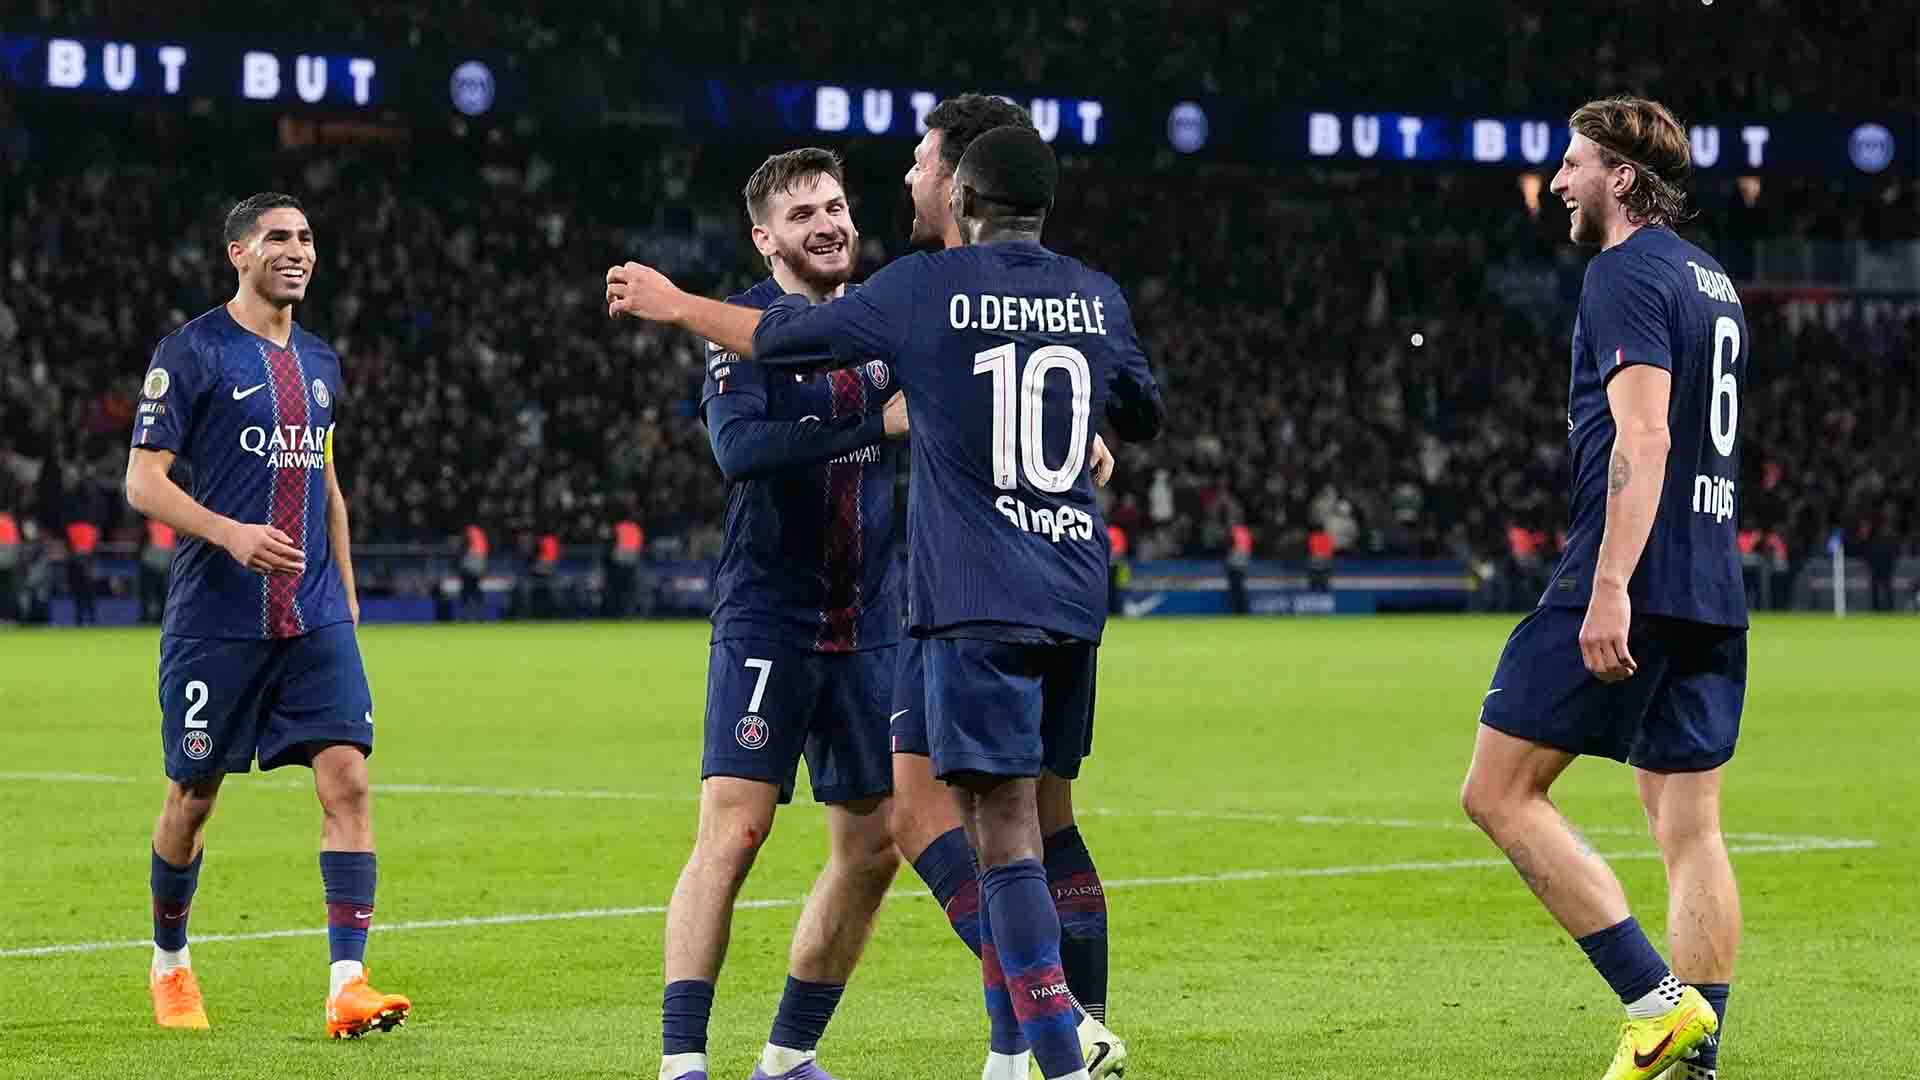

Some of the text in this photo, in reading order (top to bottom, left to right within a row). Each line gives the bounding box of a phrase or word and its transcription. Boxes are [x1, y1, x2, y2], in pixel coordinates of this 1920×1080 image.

[48, 39, 375, 105] BUT BUT
[815, 86, 1103, 144] BUT UT
[1309, 113, 1769, 168] BUT BU UT
[950, 293, 1107, 335] O.DEMBÉLÉ
[1710, 316, 1740, 457] 6
[240, 425, 325, 457] QATAR
[973, 342, 1091, 493] 10
[266, 452, 325, 469] AIRWAYS
[185, 680, 209, 729] 2
[744, 658, 773, 713] 7
[1056, 885, 1103, 899] PARIS
[1031, 983, 1070, 1000] PARIS
